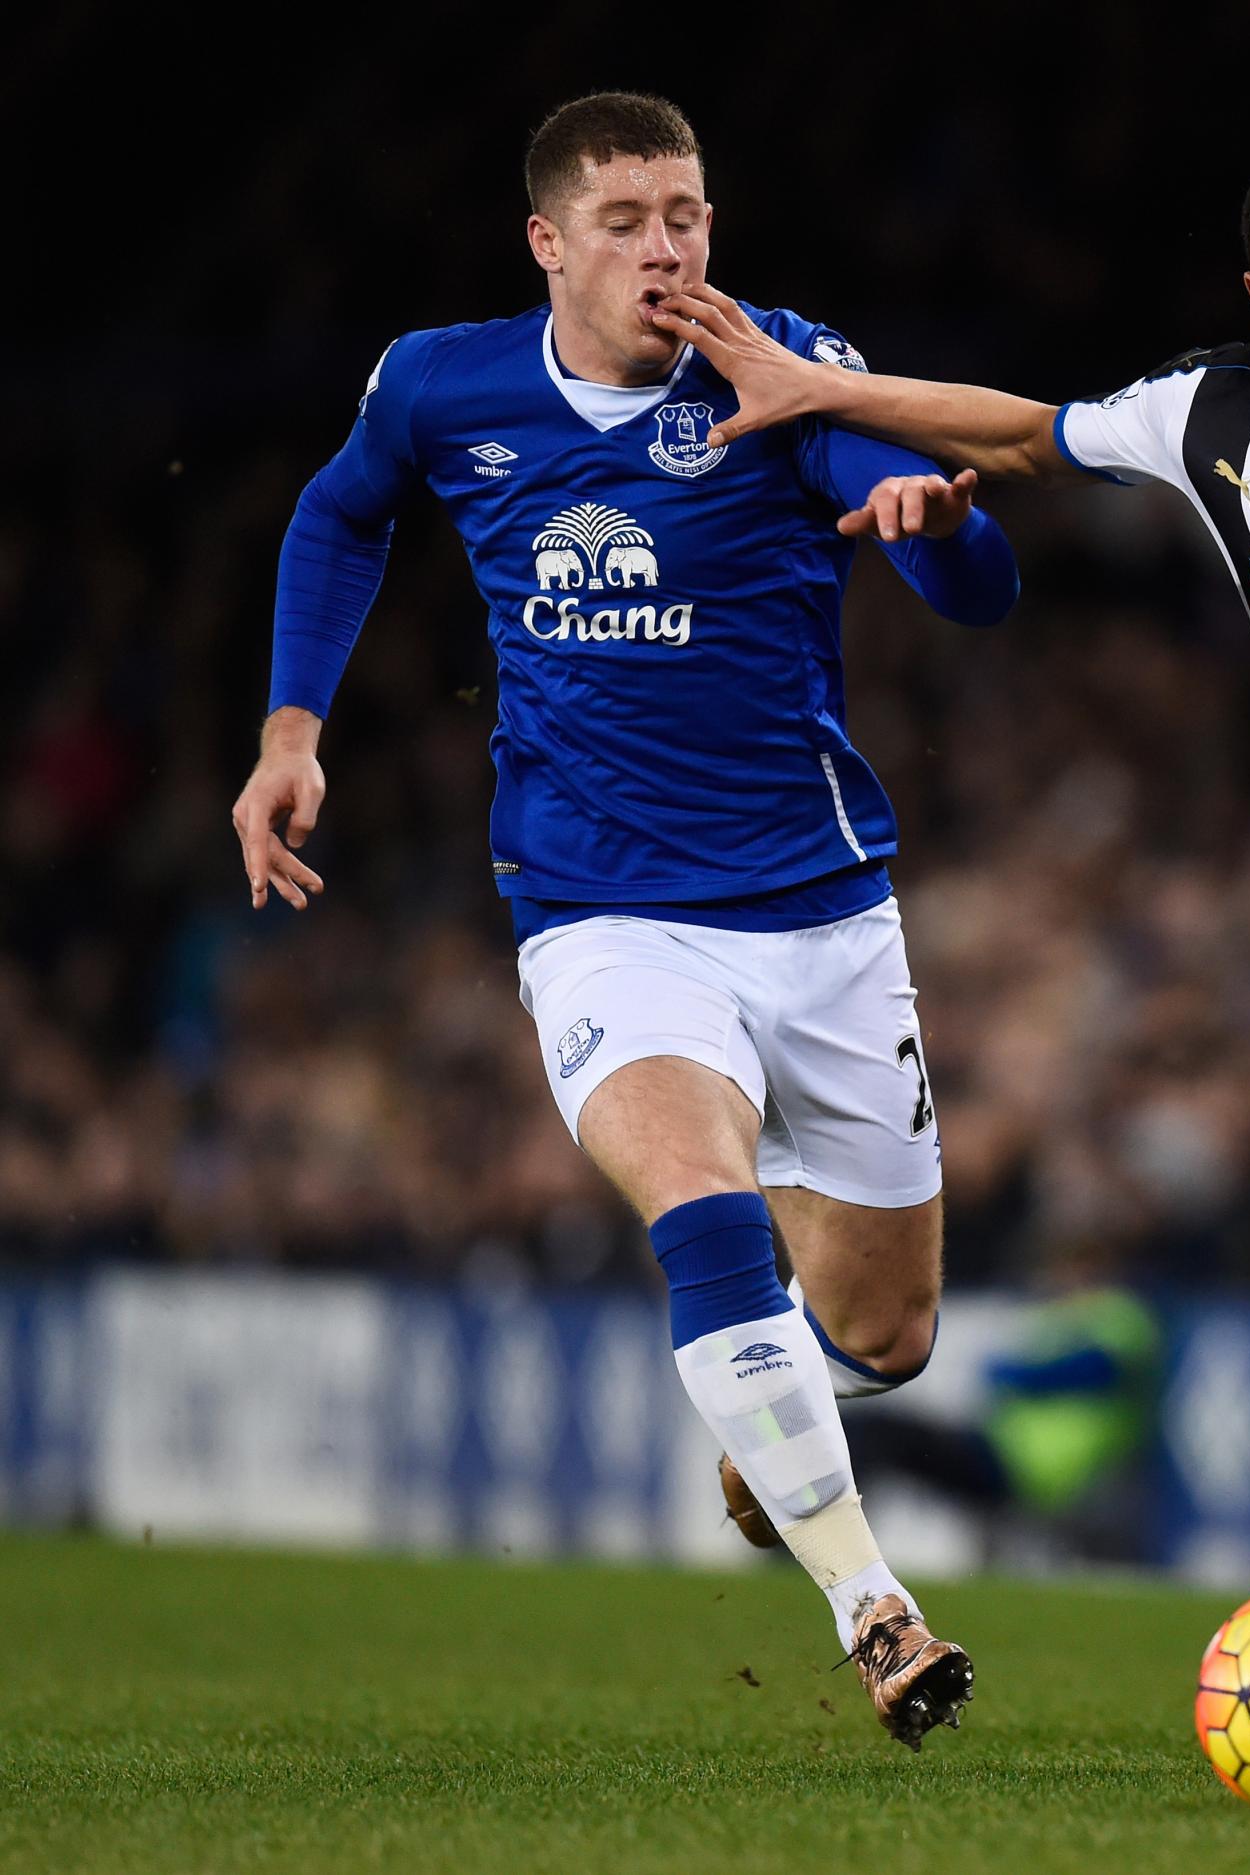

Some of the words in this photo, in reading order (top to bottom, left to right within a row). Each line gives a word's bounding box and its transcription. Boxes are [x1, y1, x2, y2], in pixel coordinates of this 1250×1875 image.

[668, 442, 709, 454] Everton
[523, 595, 693, 646] Chang
[736, 1361, 793, 1379] umbro
